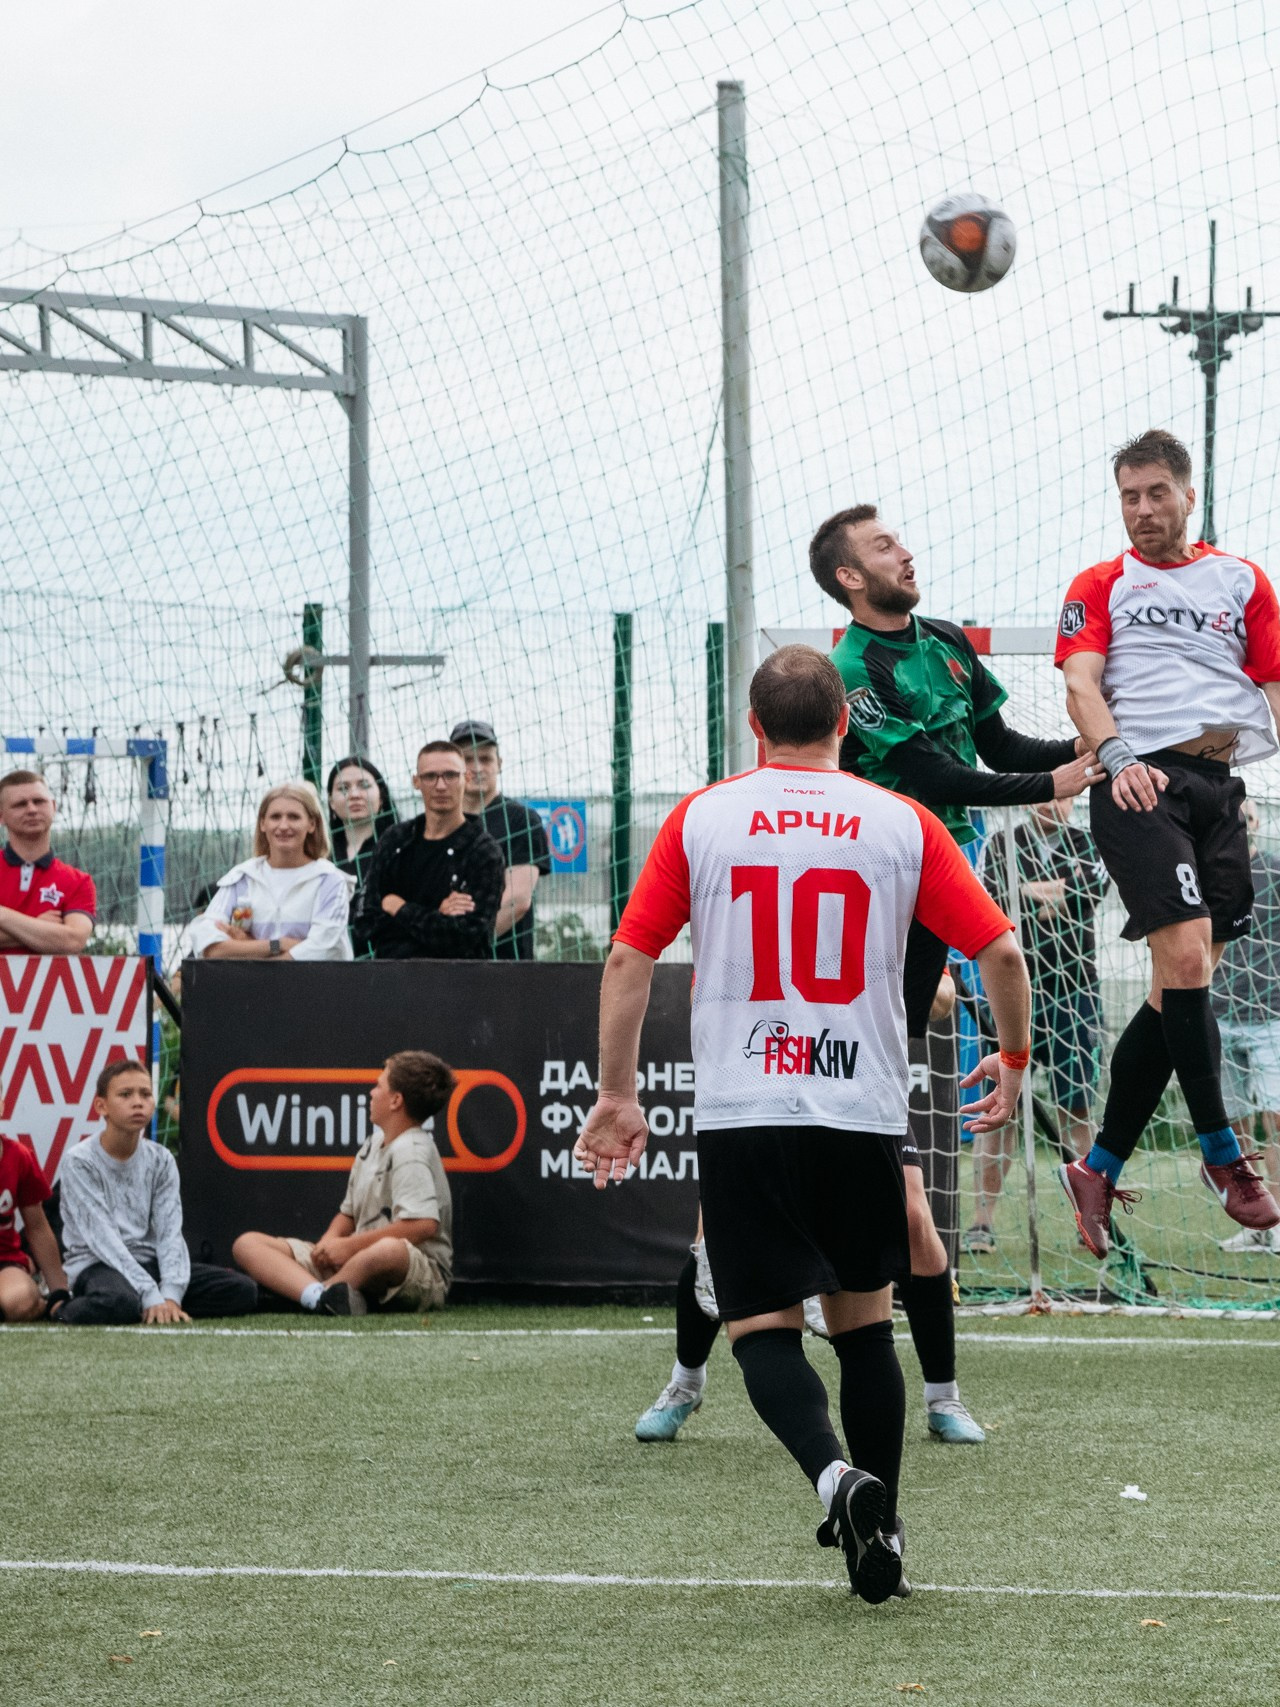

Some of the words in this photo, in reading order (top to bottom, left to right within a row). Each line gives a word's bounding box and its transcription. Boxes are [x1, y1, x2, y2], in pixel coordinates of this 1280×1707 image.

[783, 787, 826, 796] MAVEX
[748, 810, 862, 840] АРЧИ
[1175, 863, 1202, 905] 8
[730, 865, 872, 1006] 10
[236, 1093, 434, 1146] Winli
